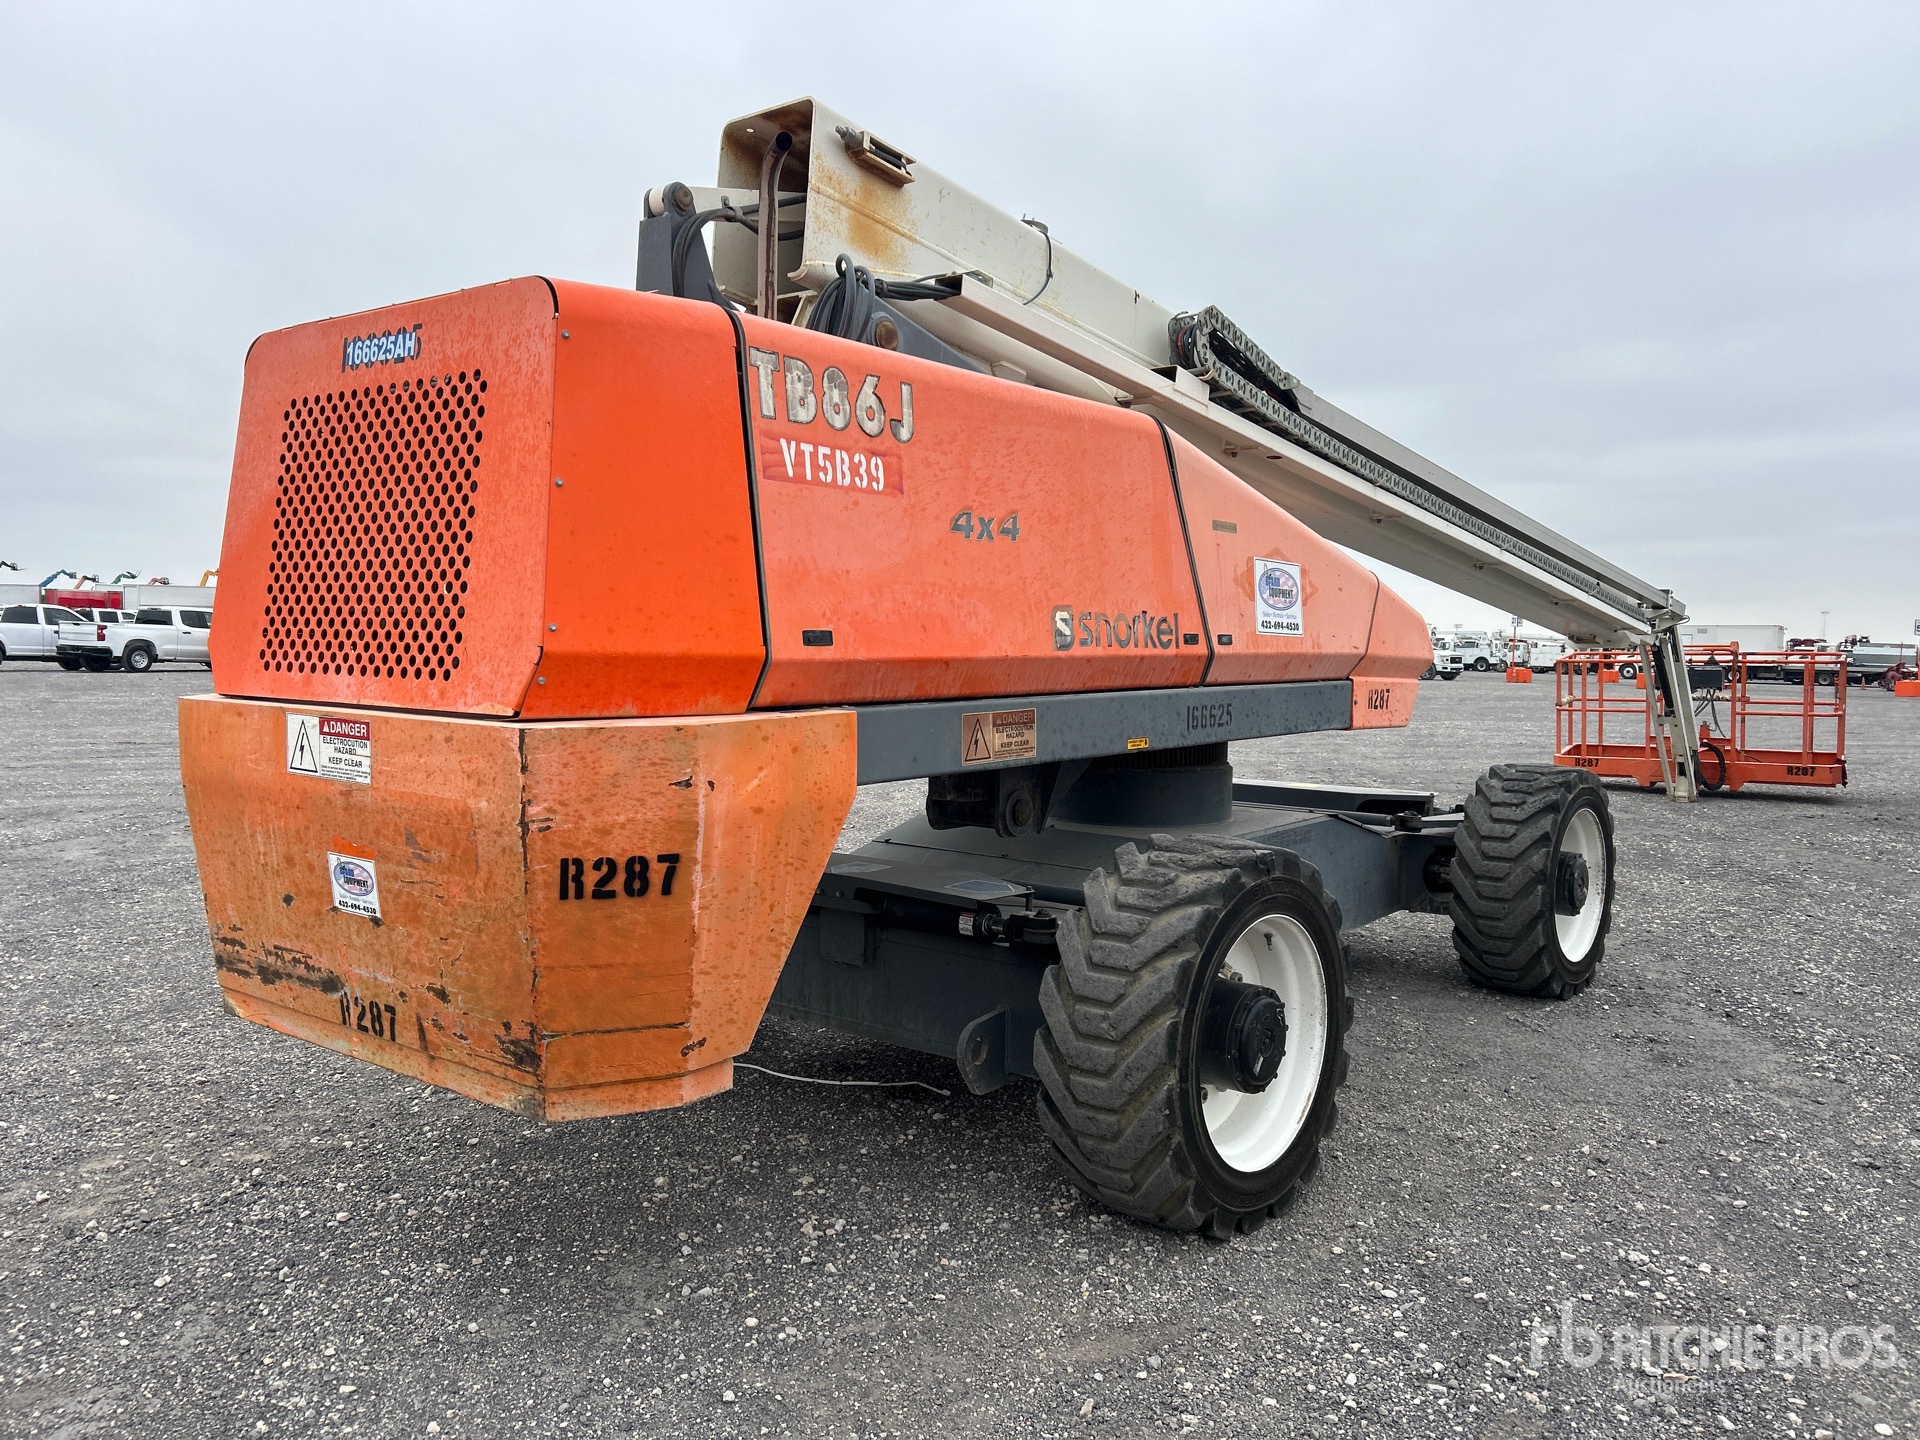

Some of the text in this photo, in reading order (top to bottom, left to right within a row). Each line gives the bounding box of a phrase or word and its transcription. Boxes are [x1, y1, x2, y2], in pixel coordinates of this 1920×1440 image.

[347, 332, 415, 365] 166625AH
[749, 346, 915, 443] TB86J
[780, 438, 885, 491] VT5B39
[950, 510, 1021, 543] 4x4
[1078, 610, 1180, 650] snorkel
[1261, 620, 1299, 631] 432-694-4530
[1368, 689, 1390, 709] R287
[1002, 712, 1033, 724] DANGER
[1187, 703, 1232, 731] 166625
[330, 721, 367, 737] DANGER
[996, 725, 1034, 734] ELECTROCUTION
[1006, 731, 1025, 739] HAZARD
[323, 736, 368, 749] ELECTROCUTION
[334, 746, 356, 755] HAZARD
[328, 757, 363, 768] KEEP CLEAR
[1575, 758, 1600, 767] R287
[1787, 766, 1816, 777] R287
[559, 853, 680, 900] R287
[338, 900, 377, 915] 432-694-4530
